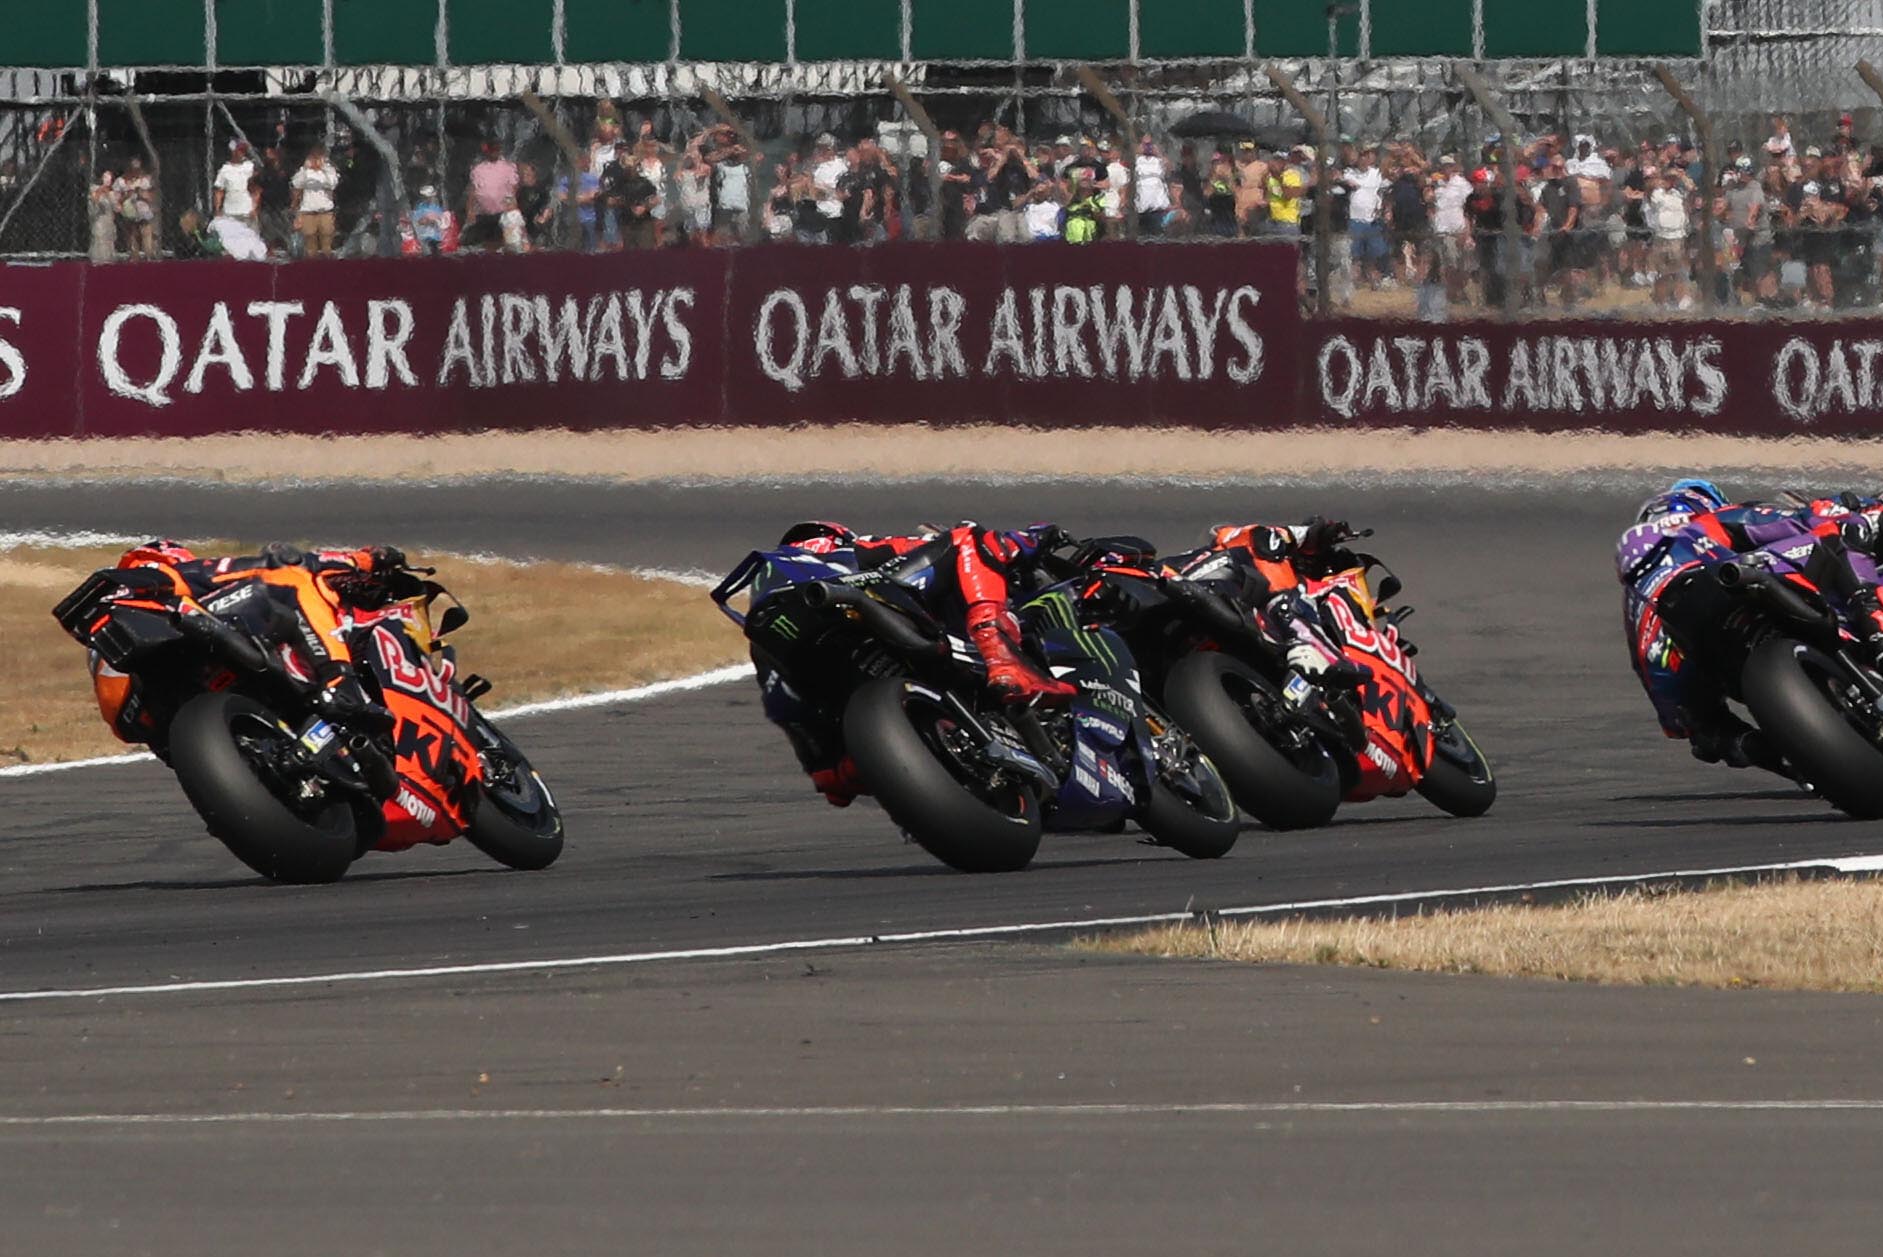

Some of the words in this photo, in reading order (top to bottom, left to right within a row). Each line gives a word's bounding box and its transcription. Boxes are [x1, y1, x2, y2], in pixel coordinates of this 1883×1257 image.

[97, 299, 418, 407] QATAR
[438, 287, 694, 389] AIRWAYS
[754, 284, 968, 392] QATAR
[982, 284, 1264, 384] AIRWAYS
[1316, 334, 1492, 419] QATAR
[1503, 334, 1727, 416] AIRWAYS
